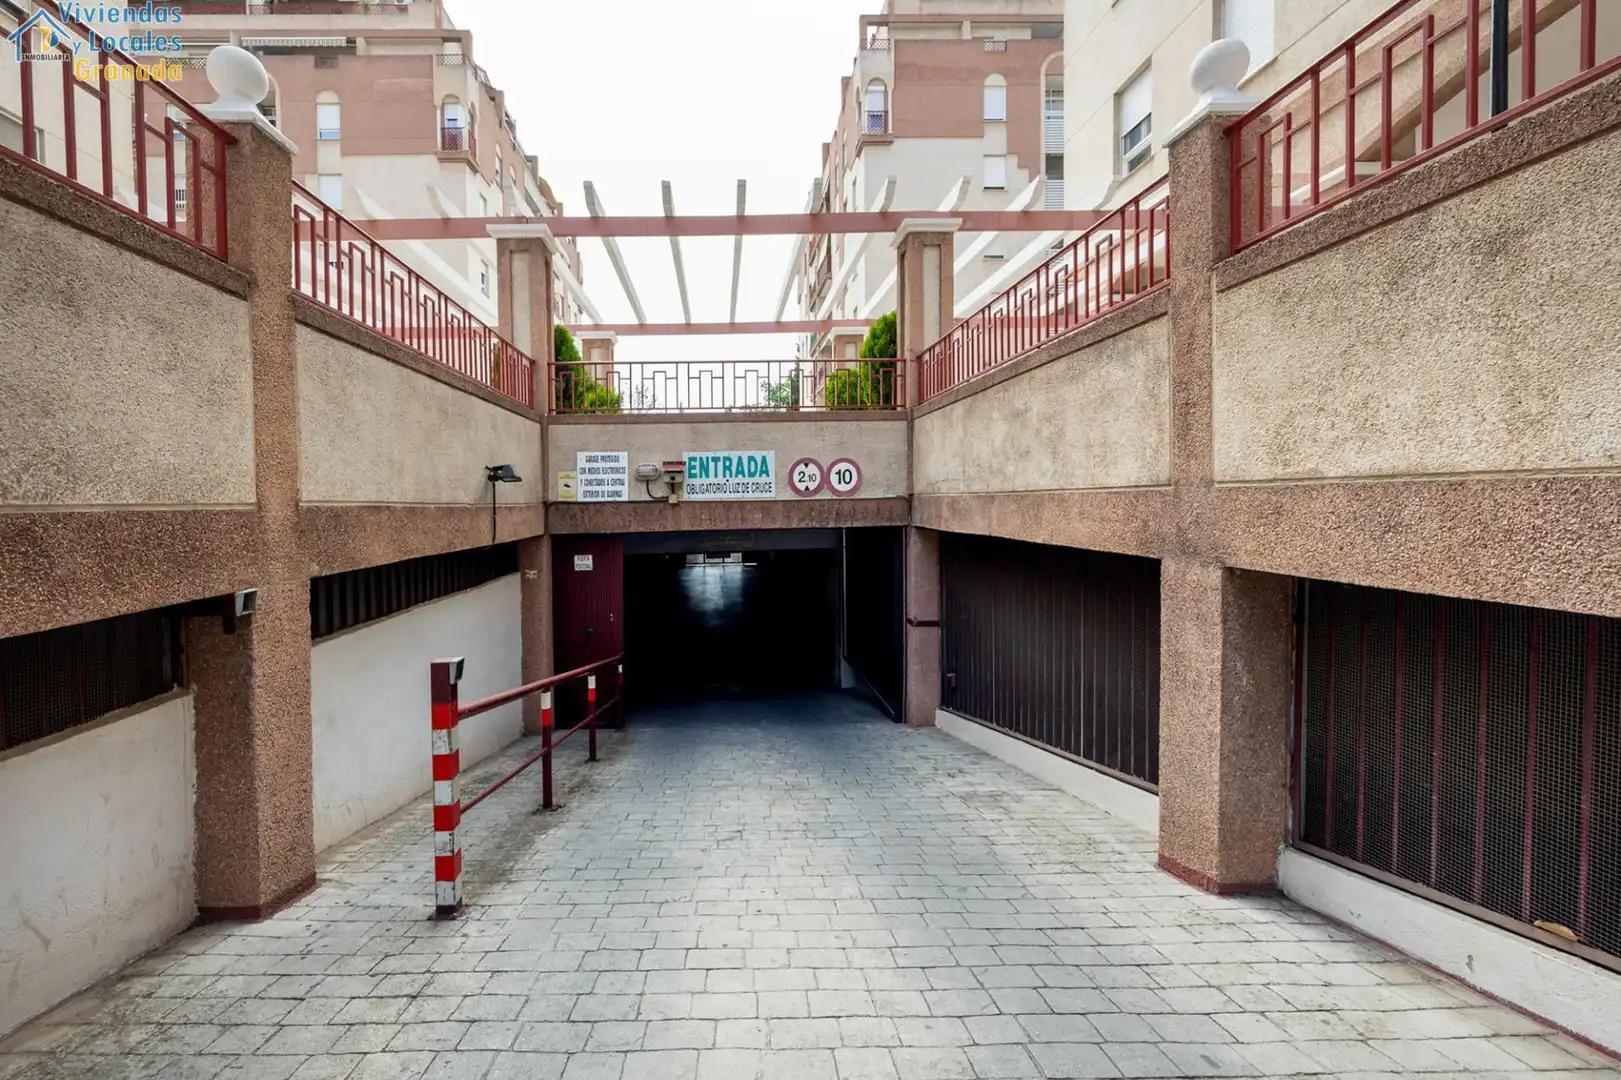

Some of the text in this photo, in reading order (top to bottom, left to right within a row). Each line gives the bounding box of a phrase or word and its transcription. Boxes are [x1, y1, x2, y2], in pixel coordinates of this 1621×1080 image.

[687, 455, 770, 479] ENTRADA
[834, 468, 853, 485] 10
[686, 481, 772, 495] OBLIGATORIO LUZ DE CRUCE
